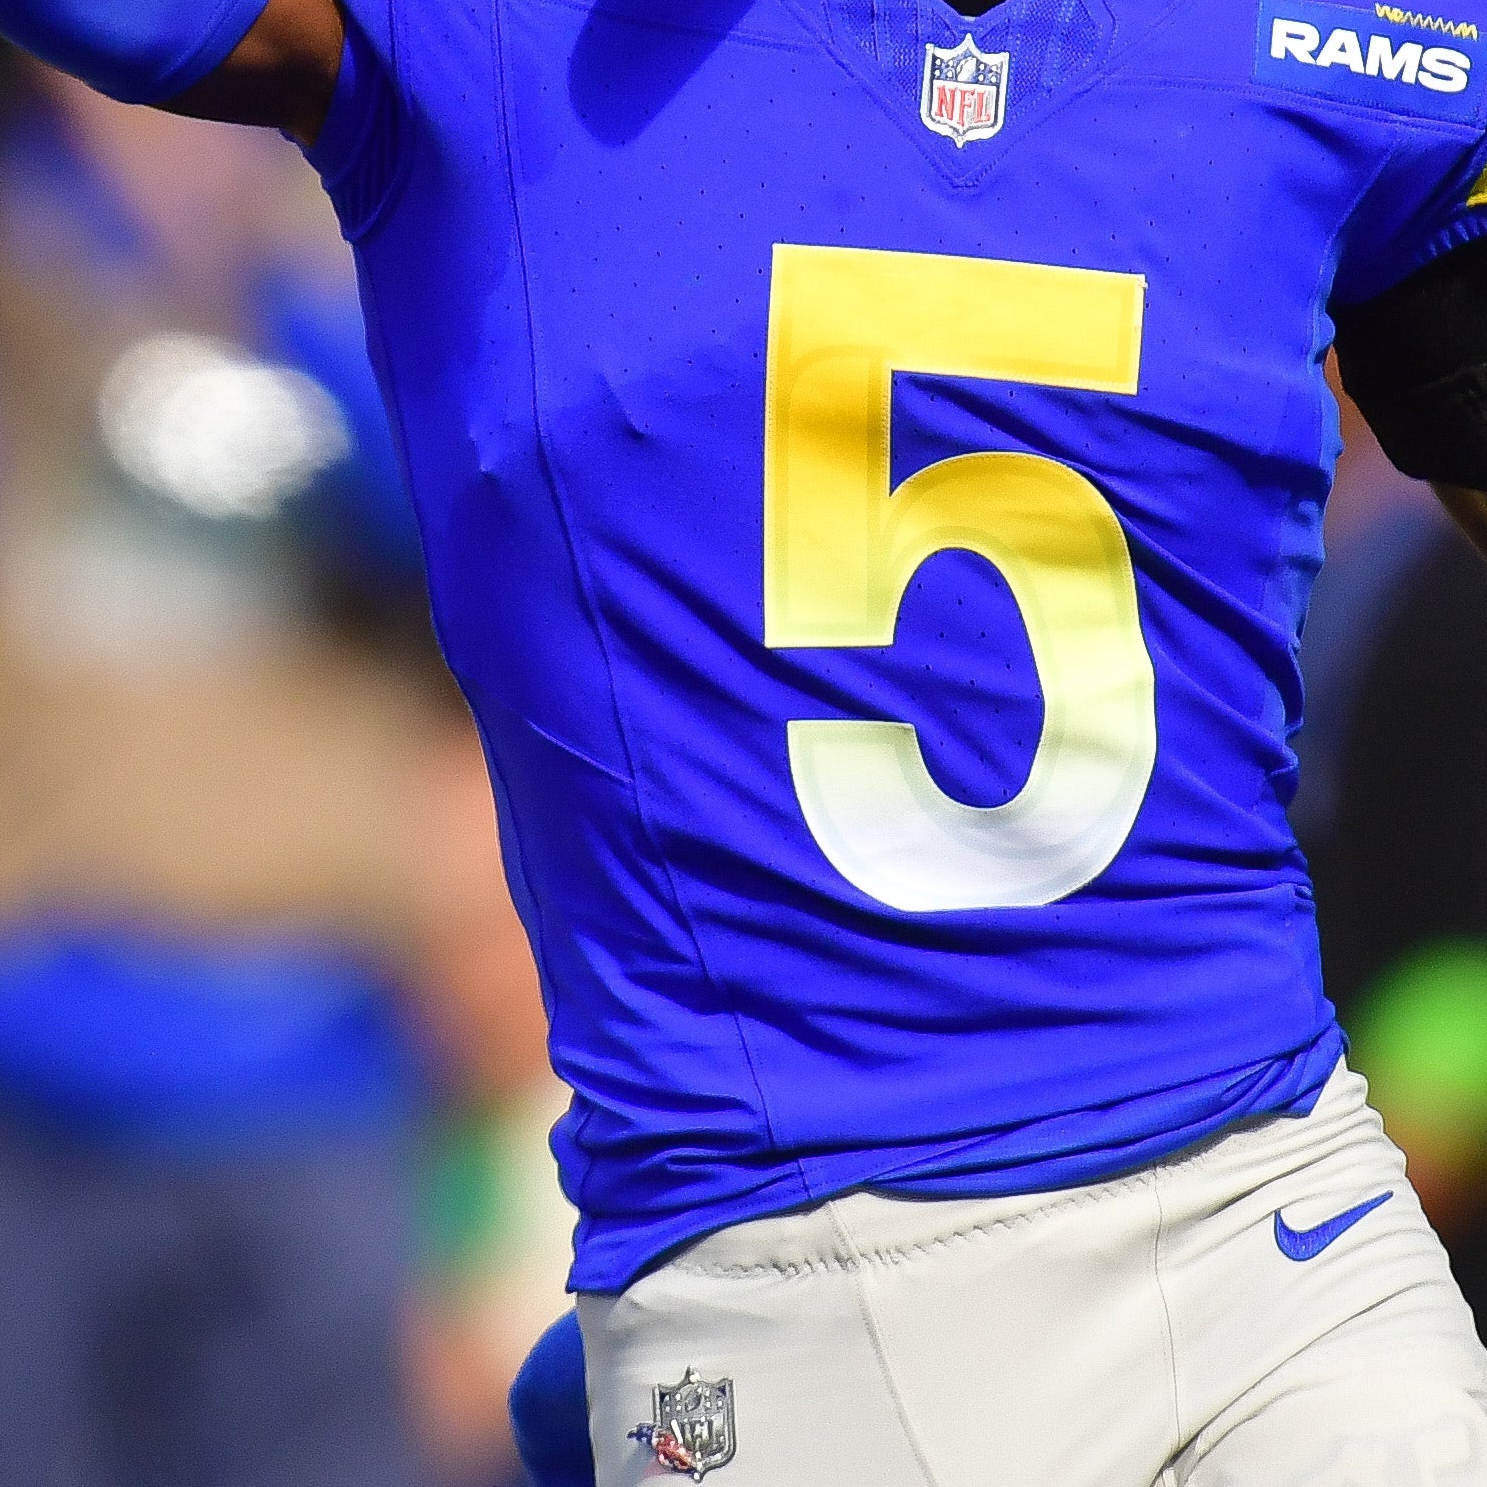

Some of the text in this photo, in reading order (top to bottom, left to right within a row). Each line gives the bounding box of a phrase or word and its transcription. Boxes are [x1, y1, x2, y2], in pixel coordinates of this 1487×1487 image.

[1270, 17, 1472, 93] RAMS
[934, 84, 991, 126] NFL
[763, 243, 1157, 913] 5
